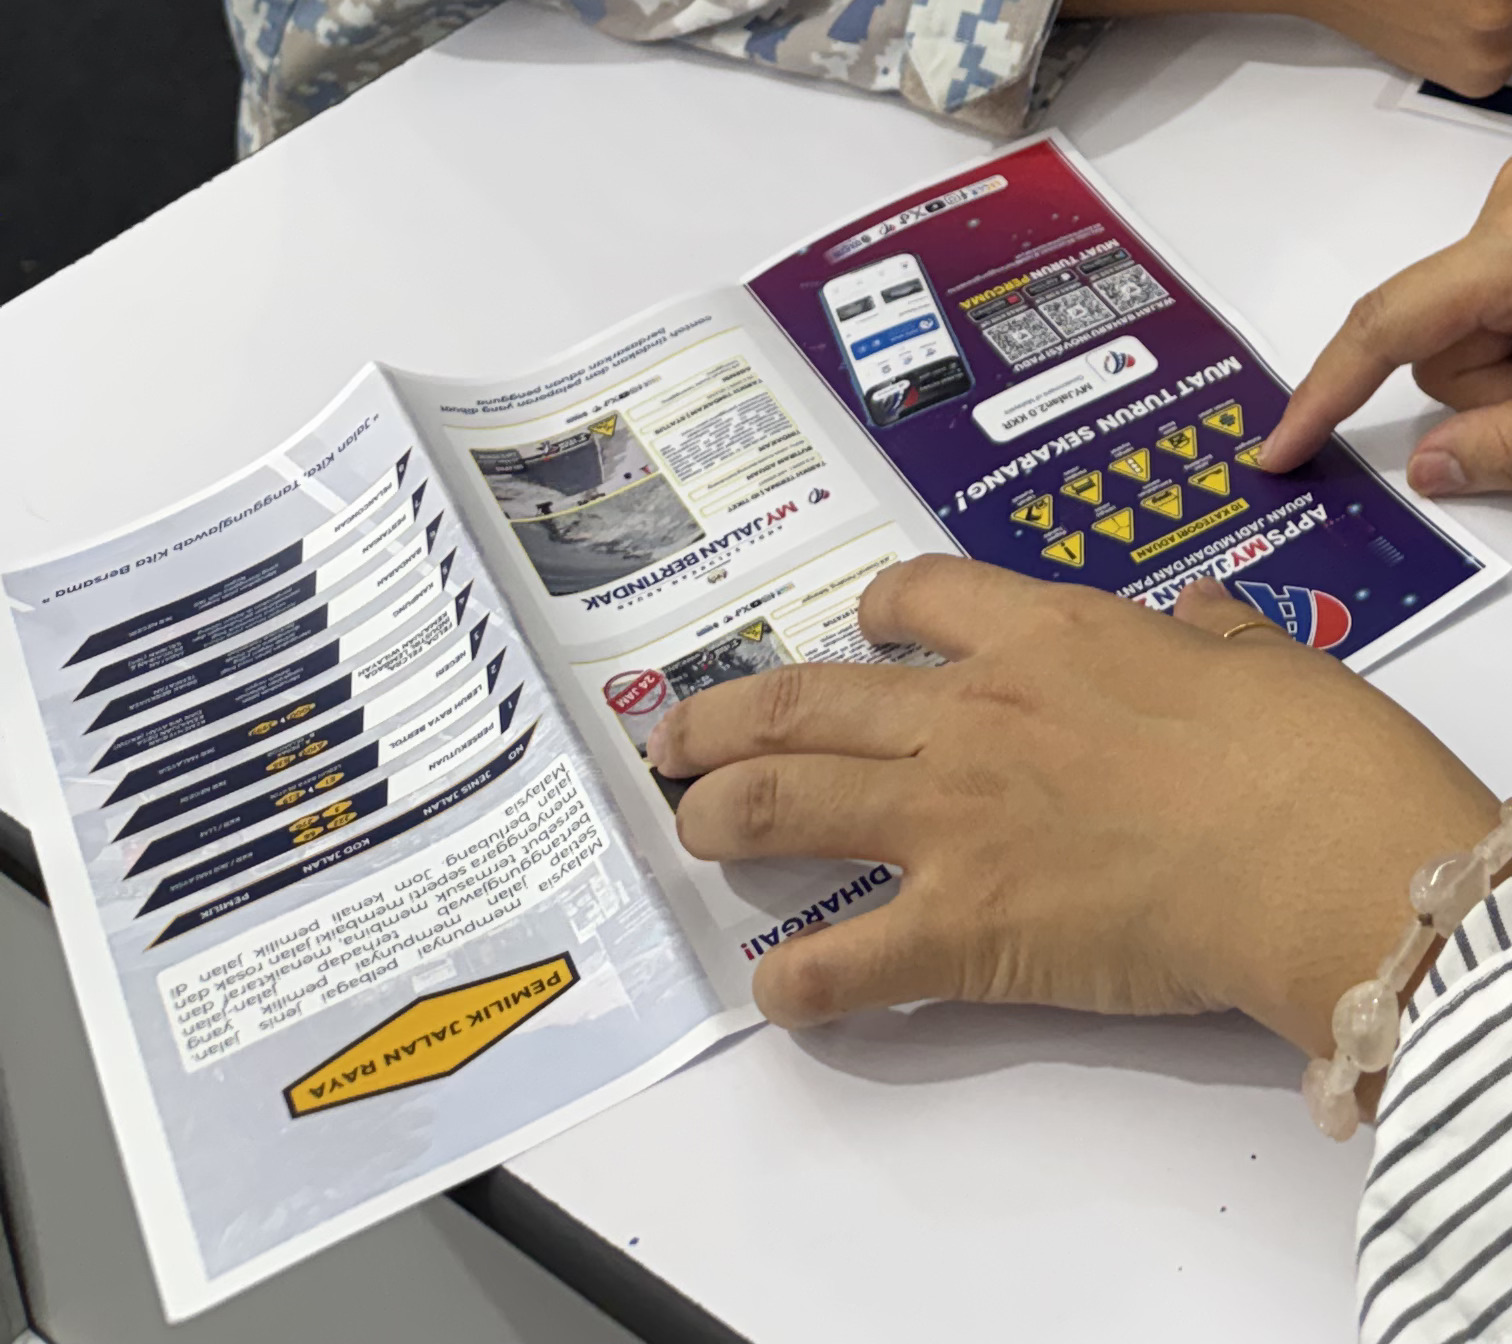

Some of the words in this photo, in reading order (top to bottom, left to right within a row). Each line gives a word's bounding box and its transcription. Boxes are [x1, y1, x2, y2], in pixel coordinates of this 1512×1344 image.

[1076, 236, 1120, 260] MUAT
[1028, 253, 1077, 281] TURUN
[957, 272, 1030, 311] PERCUMA
[610, 334, 668, 371] tindakan
[543, 367, 587, 391] aduan
[584, 365, 610, 381] dan
[1171, 353, 1243, 396] MUAT
[1000, 411, 1029, 432] KKR
[1094, 385, 1178, 434] TURUN
[335, 416, 372, 453] Jalan
[302, 451, 335, 479] Kita,
[950, 422, 1098, 512] SEKARANG!
[172, 478, 301, 553] Tanggungjawab
[1264, 489, 1314, 524] ADUAN
[1264, 501, 1329, 548] APPS
[696, 498, 800, 560] MYJALAN
[1233, 515, 1267, 540] JADI
[133, 547, 170, 570] Kita
[1135, 533, 1177, 561] ADUAN
[1182, 531, 1235, 567] MUDAH
[53, 563, 132, 600] Bersama
[374, 546, 423, 587] BANDARAN
[579, 550, 701, 612] BERTINDAK
[1153, 558, 1185, 583] DAN
[390, 581, 435, 618] KAMPUNG
[356, 647, 400, 677] WILAYAH
[432, 649, 467, 678] NEGERI
[452, 683, 483, 710] LEBUH
[614, 685, 640, 709] JAM
[637, 672, 655, 691] 24
[426, 706, 453, 727] RAYA
[387, 723, 427, 750] BERTOL
[427, 721, 495, 771] PERSEKUTUAN
[506, 742, 524, 761] NO
[459, 768, 492, 794] JENIS
[503, 760, 567, 820] Malaysia
[536, 769, 573, 809] jalan
[421, 789, 459, 816] JALAN
[469, 786, 578, 871] menyenggara
[520, 798, 585, 856] tersebut
[548, 823, 598, 868] Setiap
[300, 849, 341, 874] JALAN
[341, 836, 370, 856] KOD
[394, 866, 433, 894] Jom
[407, 863, 467, 904] seperti
[433, 851, 516, 905] termasuk
[435, 810, 591, 920] bertanggungjawab
[537, 836, 603, 895] Malaysia
[198, 890, 250, 920] PEMILIK
[331, 890, 384, 925] kenali
[486, 873, 530, 909] jalan
[315, 895, 405, 947] membaiki
[337, 899, 428, 951] membina,
[415, 896, 522, 960] mempunyai
[739, 862, 893, 963] DIHARGAI!
[253, 918, 320, 961] pemilik
[267, 935, 313, 968] jalan
[315, 927, 400, 976] terhadap
[353, 911, 462, 974] mempunyai
[198, 951, 245, 985] jalan
[213, 960, 263, 993] rosak
[219, 943, 332, 1008] menaiktaraf
[319, 956, 399, 1004] pelbagai
[168, 980, 189, 1000] di
[173, 986, 211, 1013] dan
[260, 973, 329, 1018] pemilik
[465, 968, 563, 1028] PEMILIK
[176, 998, 216, 1026] dan
[257, 1000, 304, 1034] jenis
[185, 1017, 234, 1051] yang
[189, 1029, 243, 1067] jalan.
[382, 1018, 463, 1067] JALAN
[307, 1058, 378, 1102] RAYA
